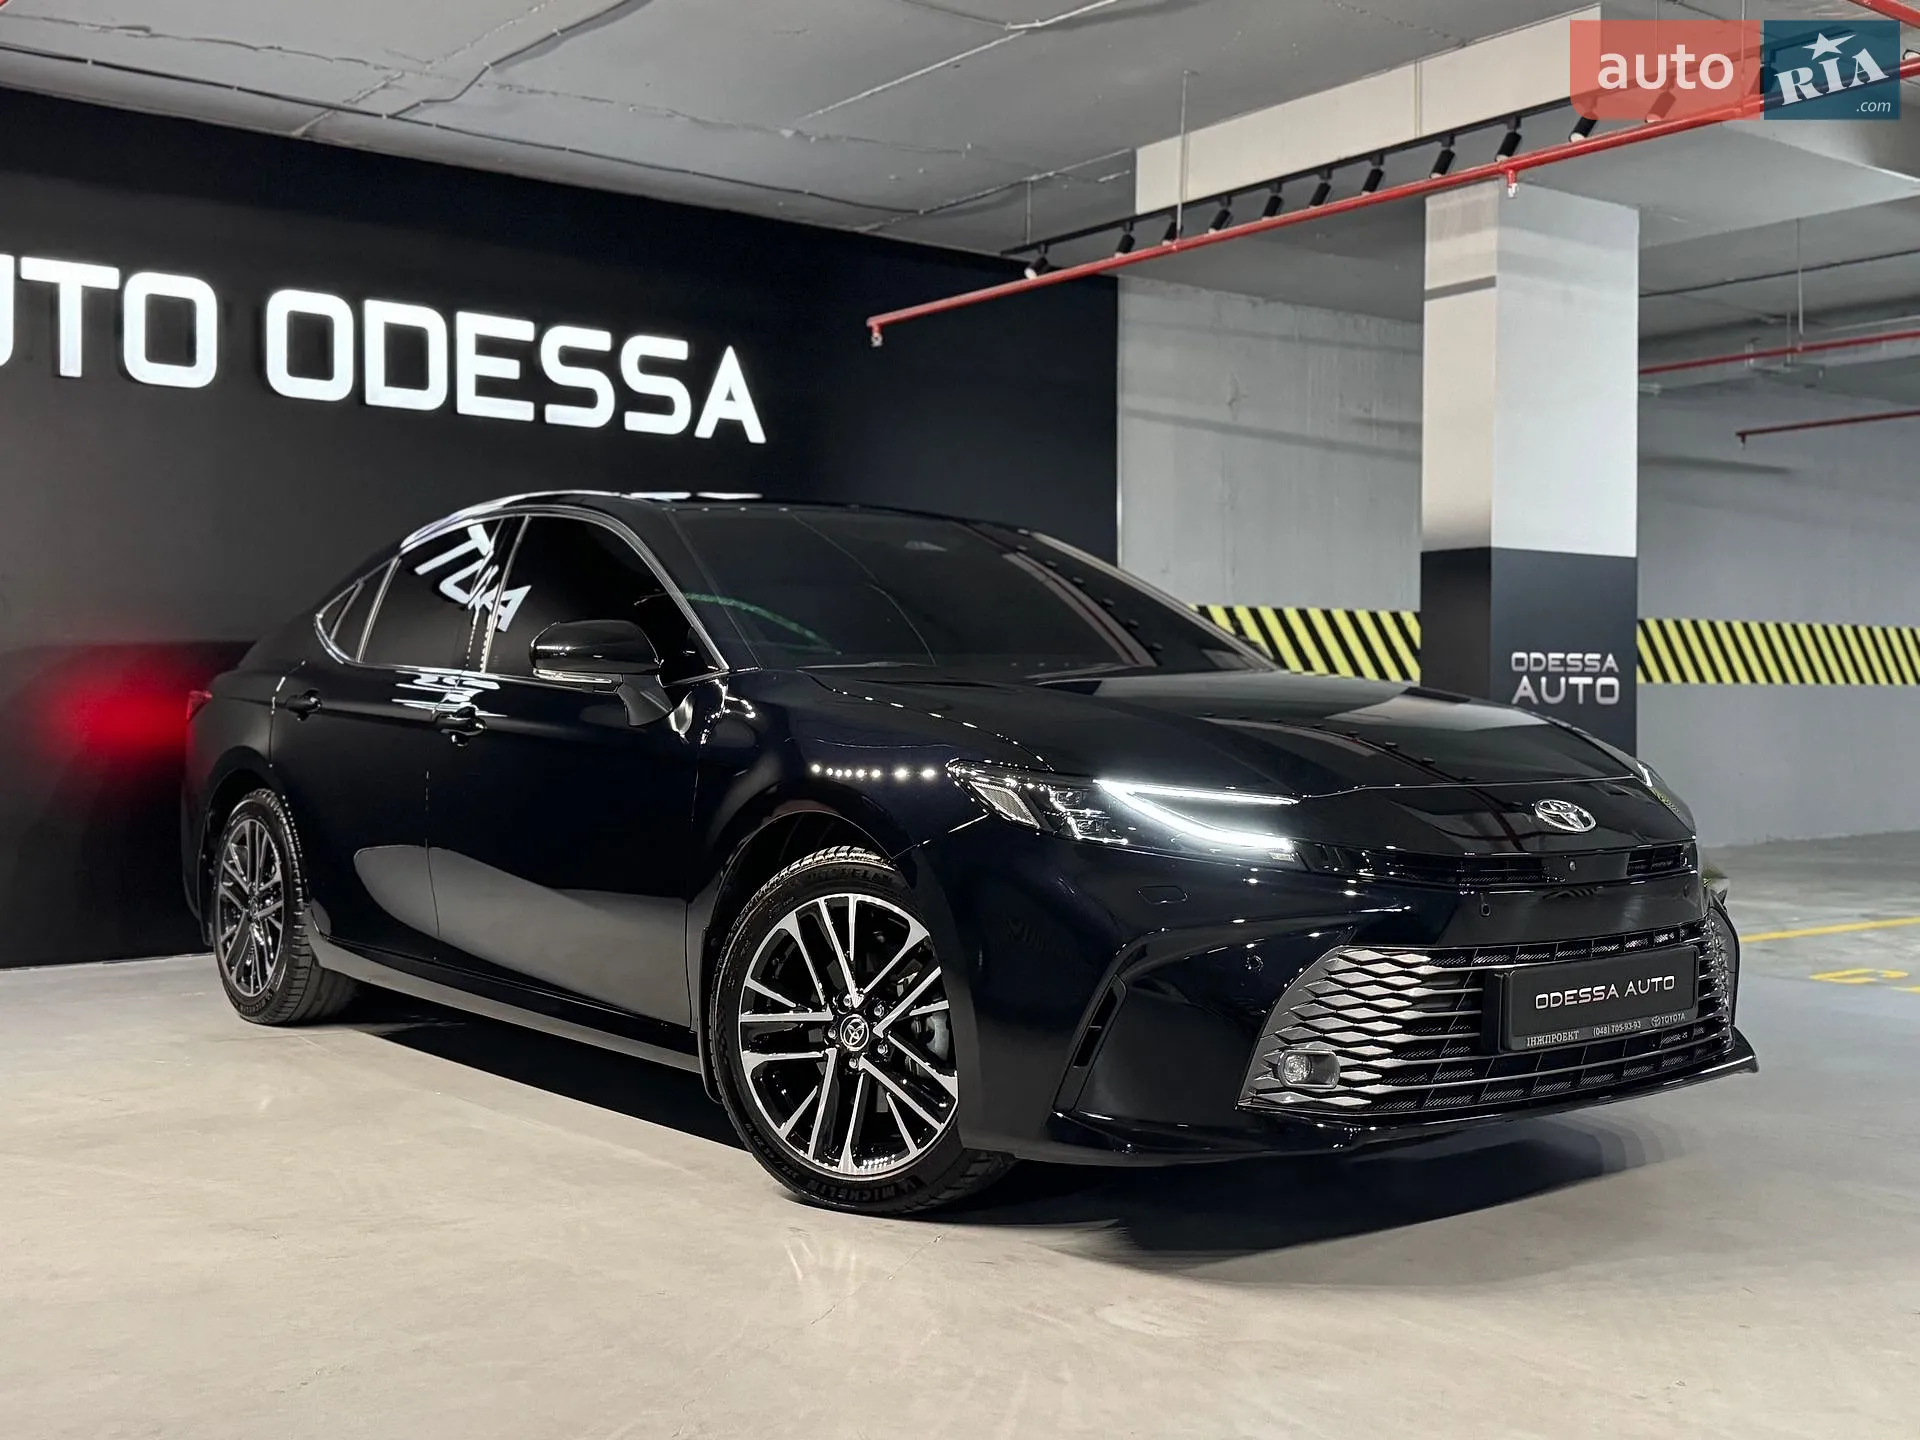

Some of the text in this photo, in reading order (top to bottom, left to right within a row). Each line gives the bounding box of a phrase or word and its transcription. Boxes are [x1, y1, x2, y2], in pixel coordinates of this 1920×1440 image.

[0, 253, 767, 444] TO ODESSA
[1511, 652, 1619, 672] ODESSA
[1511, 675, 1619, 704] AUTO
[1535, 975, 1675, 1010] ODESSA AUTO
[1661, 1012, 1686, 1025] TOYOTA
